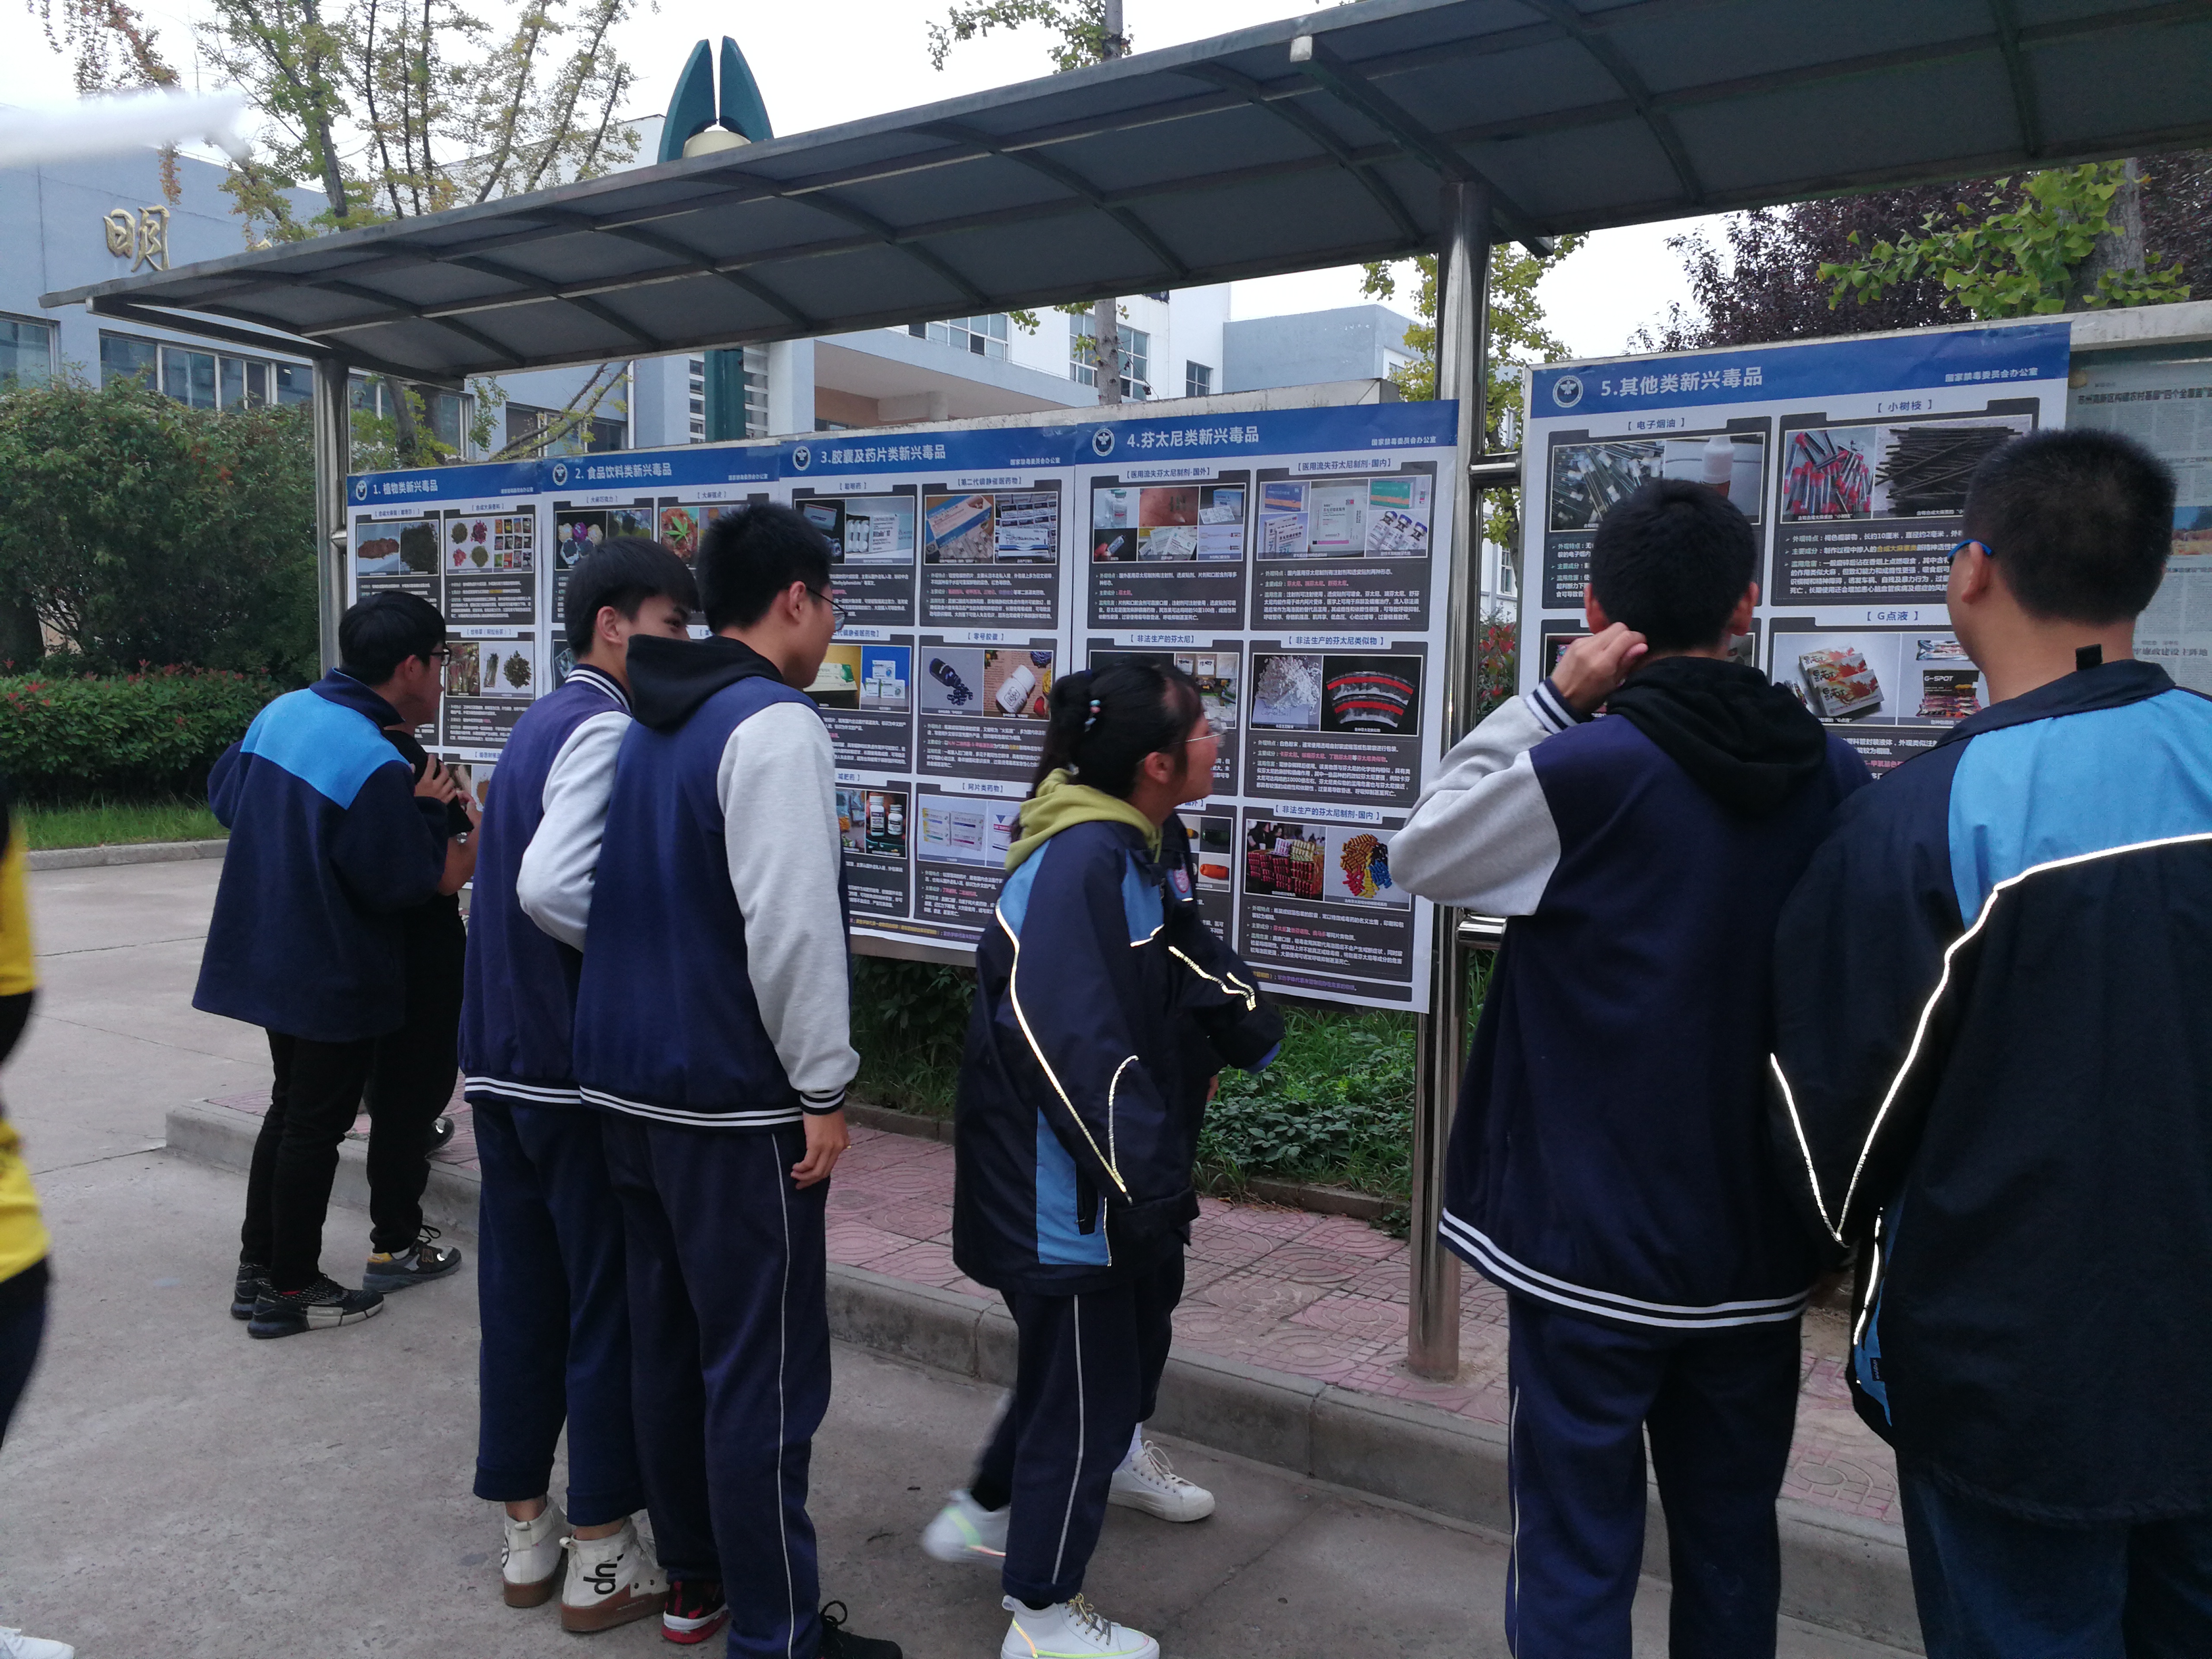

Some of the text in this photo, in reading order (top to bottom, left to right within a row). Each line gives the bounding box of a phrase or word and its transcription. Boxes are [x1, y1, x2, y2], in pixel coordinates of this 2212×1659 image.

[1601, 366, 1762, 397] 5.其他类新兴毒品
[1945, 368, 2038, 382] 国家禁毒委员会办公室
[1127, 426, 1259, 448] 4.芬太尼类新兴毒品
[1371, 436, 1437, 446] 国家禁毒委员会办公室
[821, 444, 946, 464] 3.胶囊及药片类新兴毒品
